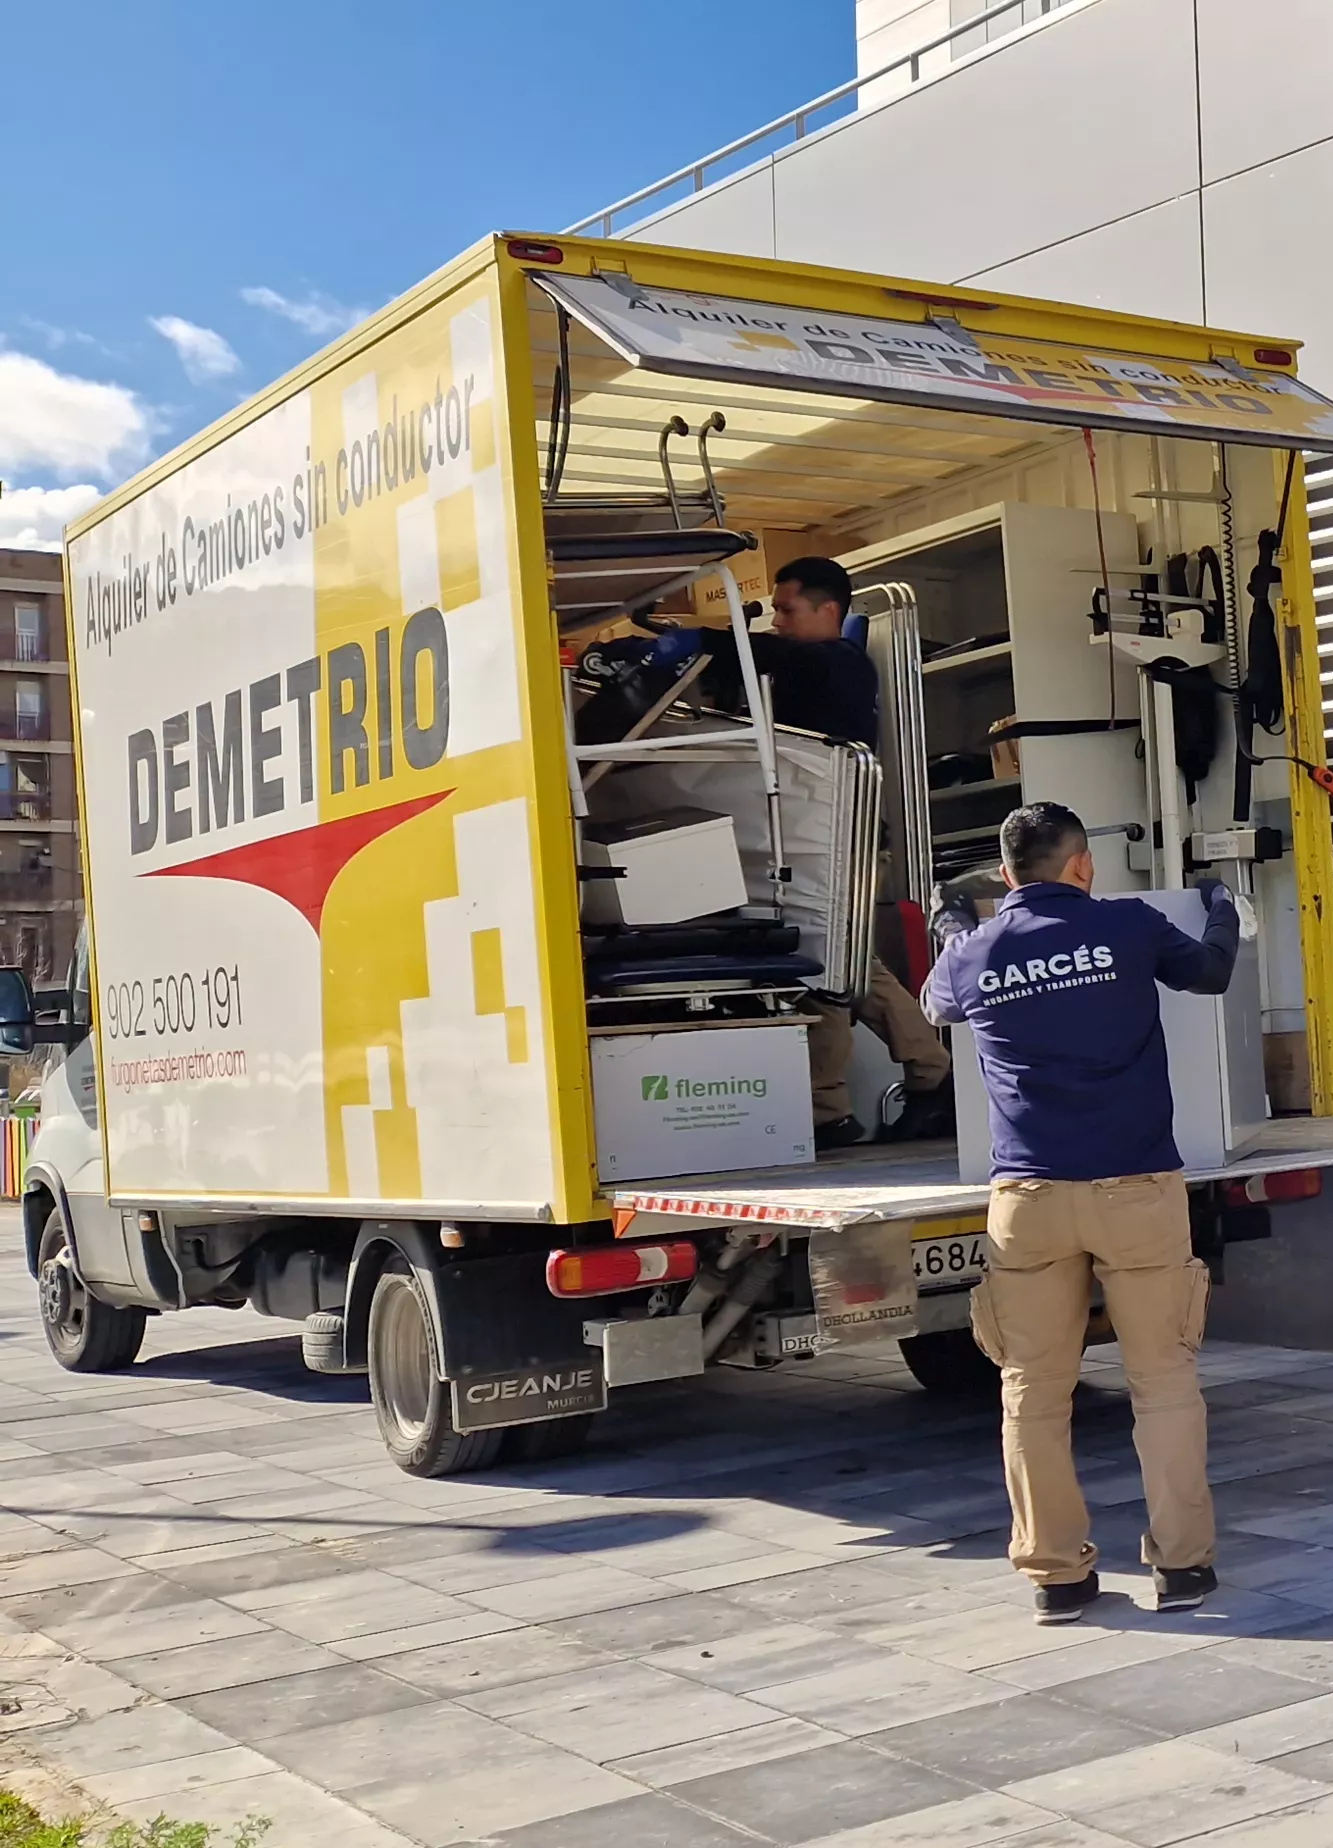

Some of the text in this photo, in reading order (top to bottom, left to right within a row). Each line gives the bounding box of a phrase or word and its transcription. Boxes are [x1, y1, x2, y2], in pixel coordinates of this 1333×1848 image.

[628, 299, 1282, 395] Alquiler de Camiones sin conductor
[804, 338, 1273, 415] DEMETRIO
[86, 372, 475, 657] Alquiler de Camiones sin conductor
[706, 577, 761, 602] MASRTEC
[127, 606, 450, 856] DEMETRIO
[978, 945, 1114, 993] GARCÉS
[983, 972, 1117, 1007] MUDANZAS Y TRANSPORTES
[107, 963, 242, 1039] 902 500 191
[110, 1045, 247, 1094] furgonetasdemetrio.com
[675, 1076, 767, 1101] fleming
[824, 1305, 913, 1328] DHOLLANDIA
[466, 1369, 593, 1404] CJEANJE
